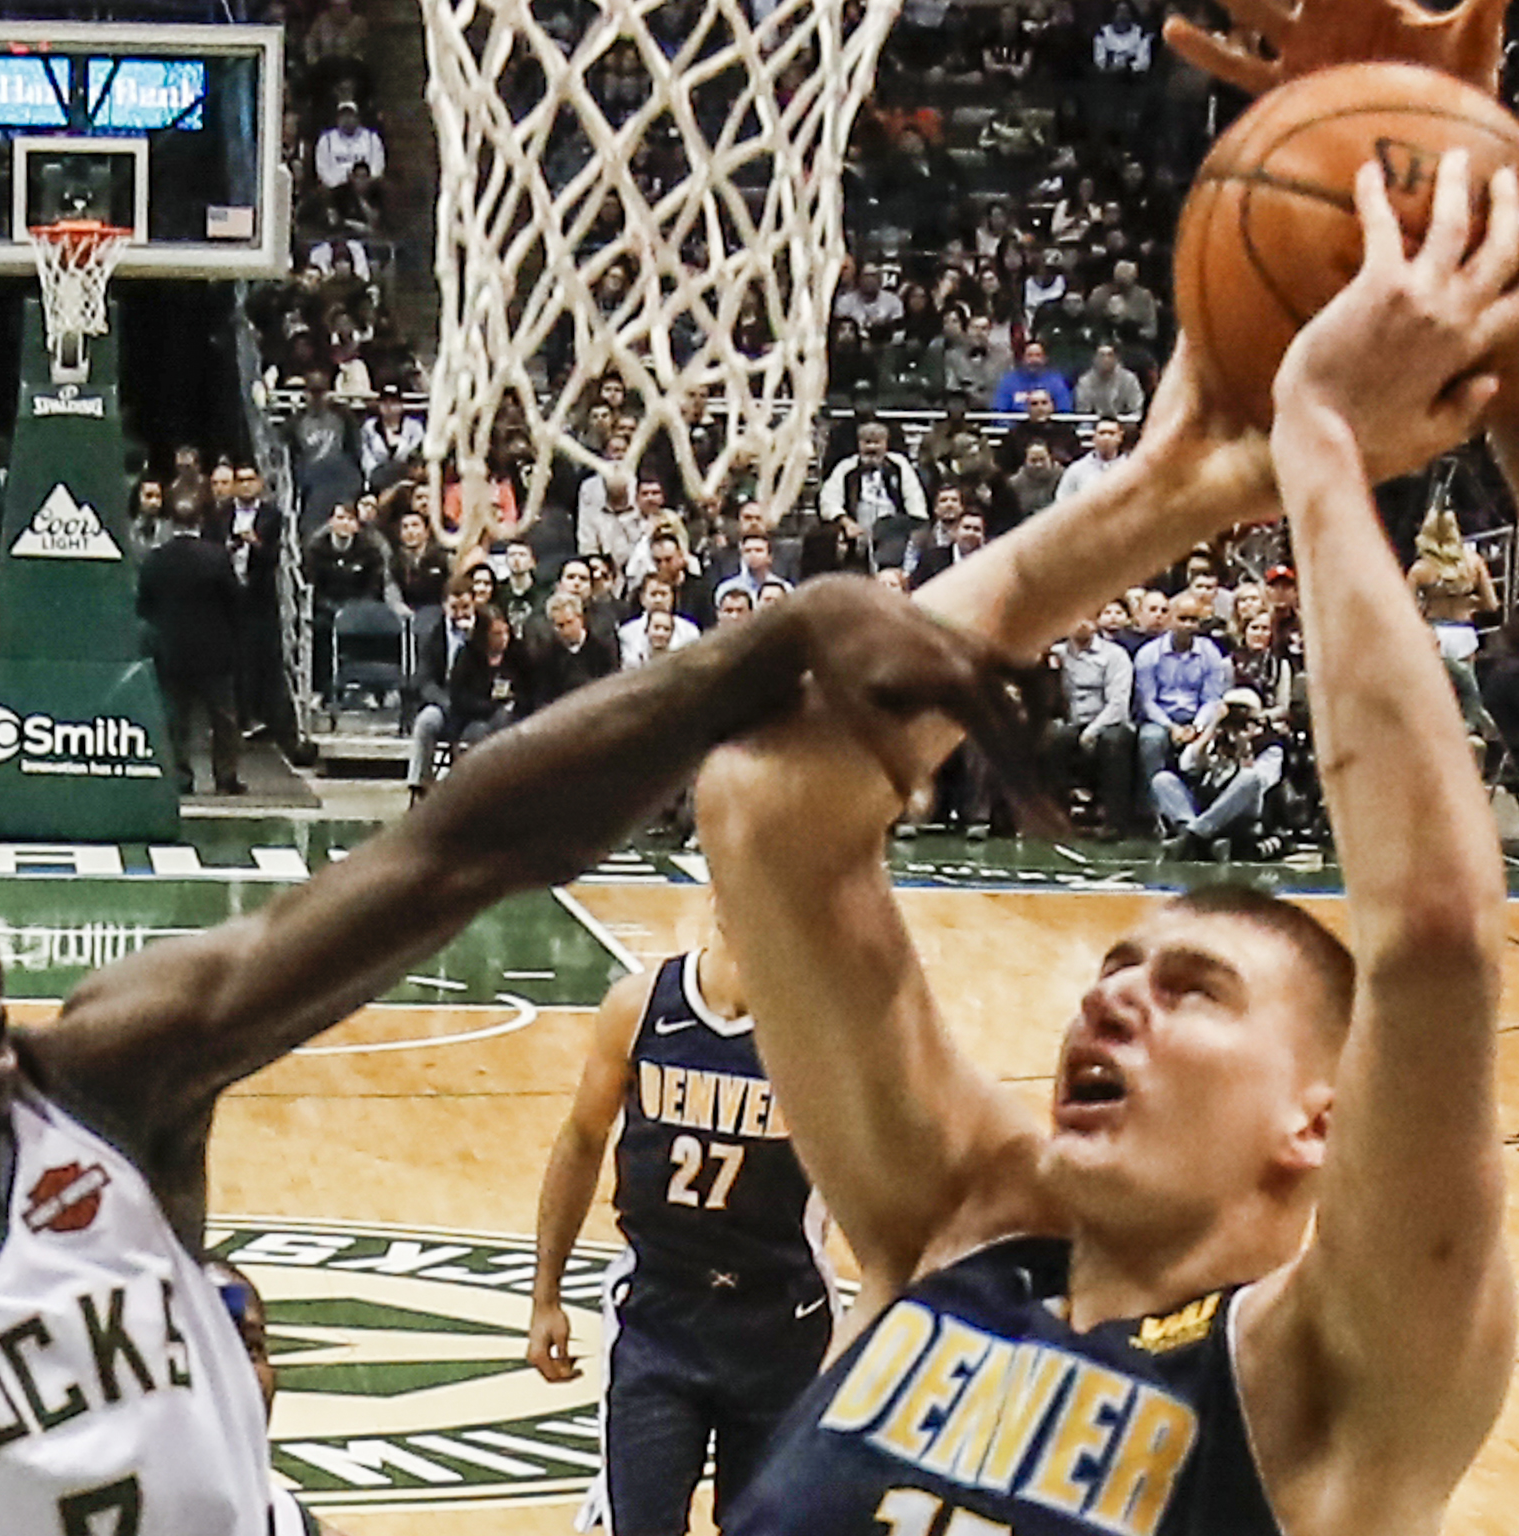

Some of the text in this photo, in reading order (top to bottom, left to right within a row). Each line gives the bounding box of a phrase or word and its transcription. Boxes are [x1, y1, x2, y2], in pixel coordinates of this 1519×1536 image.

[32, 507, 104, 536] Coors
[42, 536, 89, 550] LIGHT
[666, 1134, 746, 1211] 27
